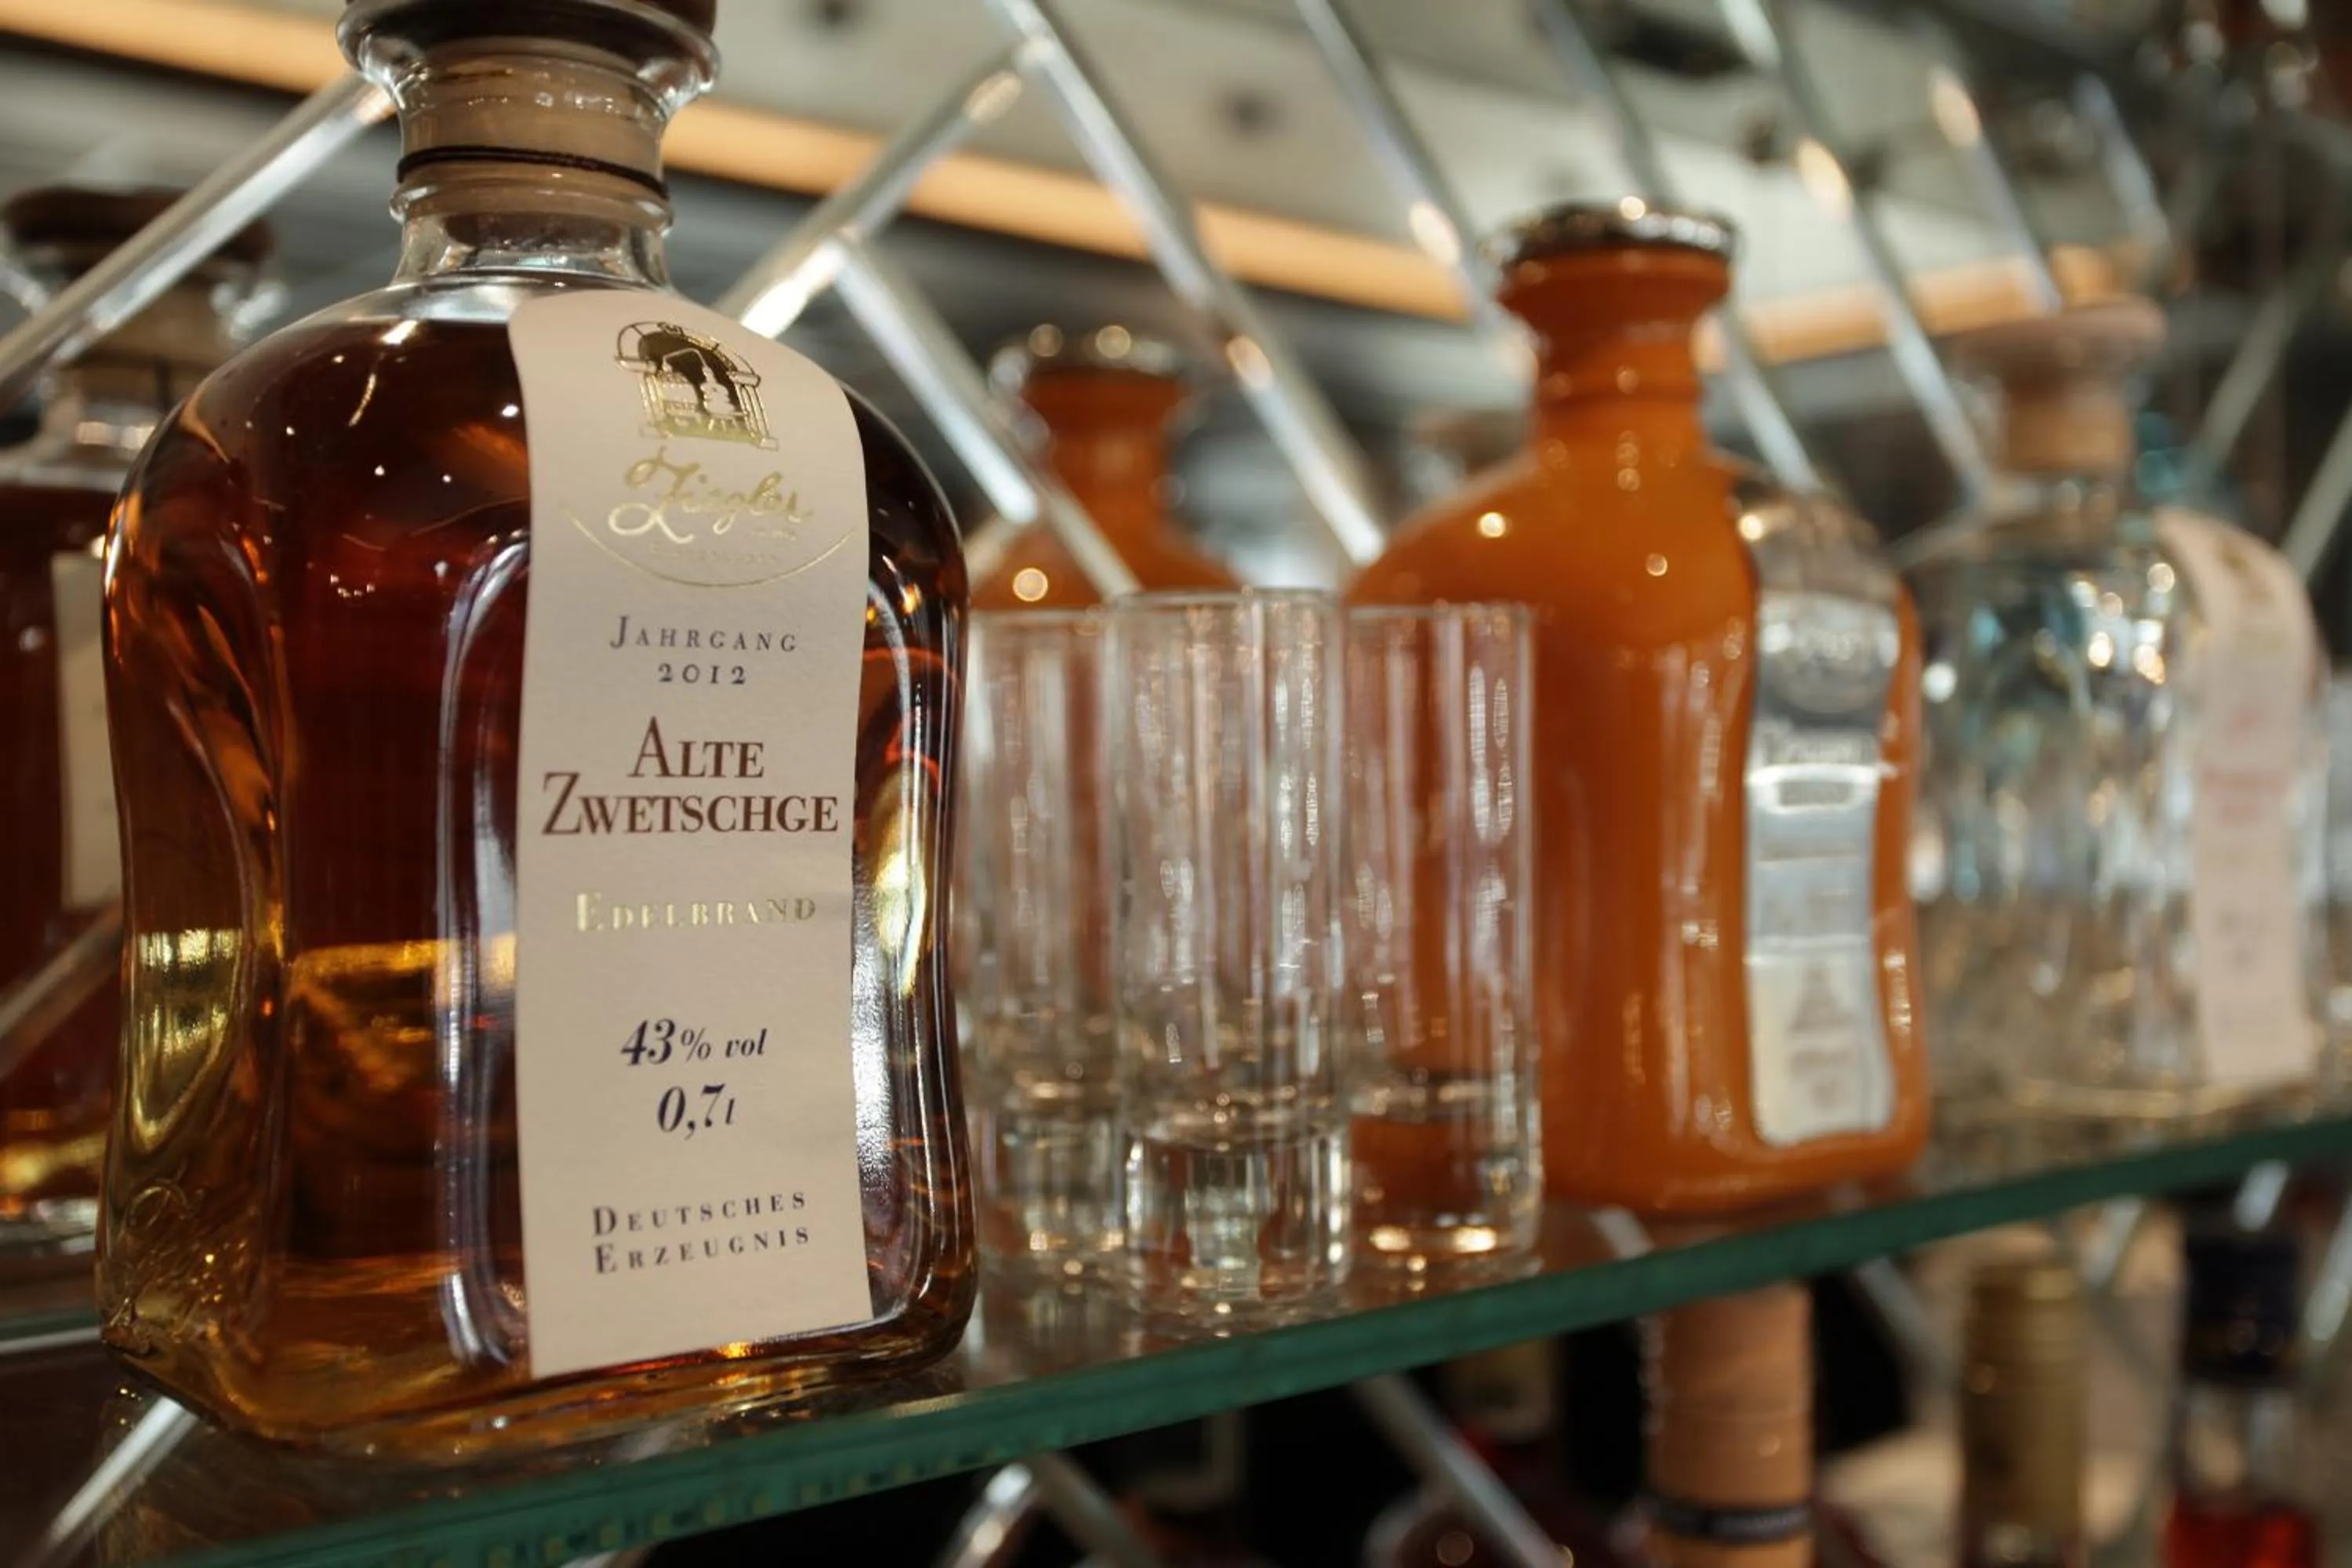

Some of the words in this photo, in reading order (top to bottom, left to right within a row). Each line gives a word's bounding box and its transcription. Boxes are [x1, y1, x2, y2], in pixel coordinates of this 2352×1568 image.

[609, 615, 797, 652] JAHRGANG
[657, 662, 747, 685] 2012
[626, 715, 764, 779] ALTE
[541, 771, 839, 835] ZWETSCHGE
[575, 891, 817, 932] EDELBRAND
[619, 1018, 712, 1066] 43%
[724, 1027, 768, 1058] vol
[591, 1192, 807, 1236] DEUTSCHES
[593, 1226, 811, 1275] ERZEUGNIS
